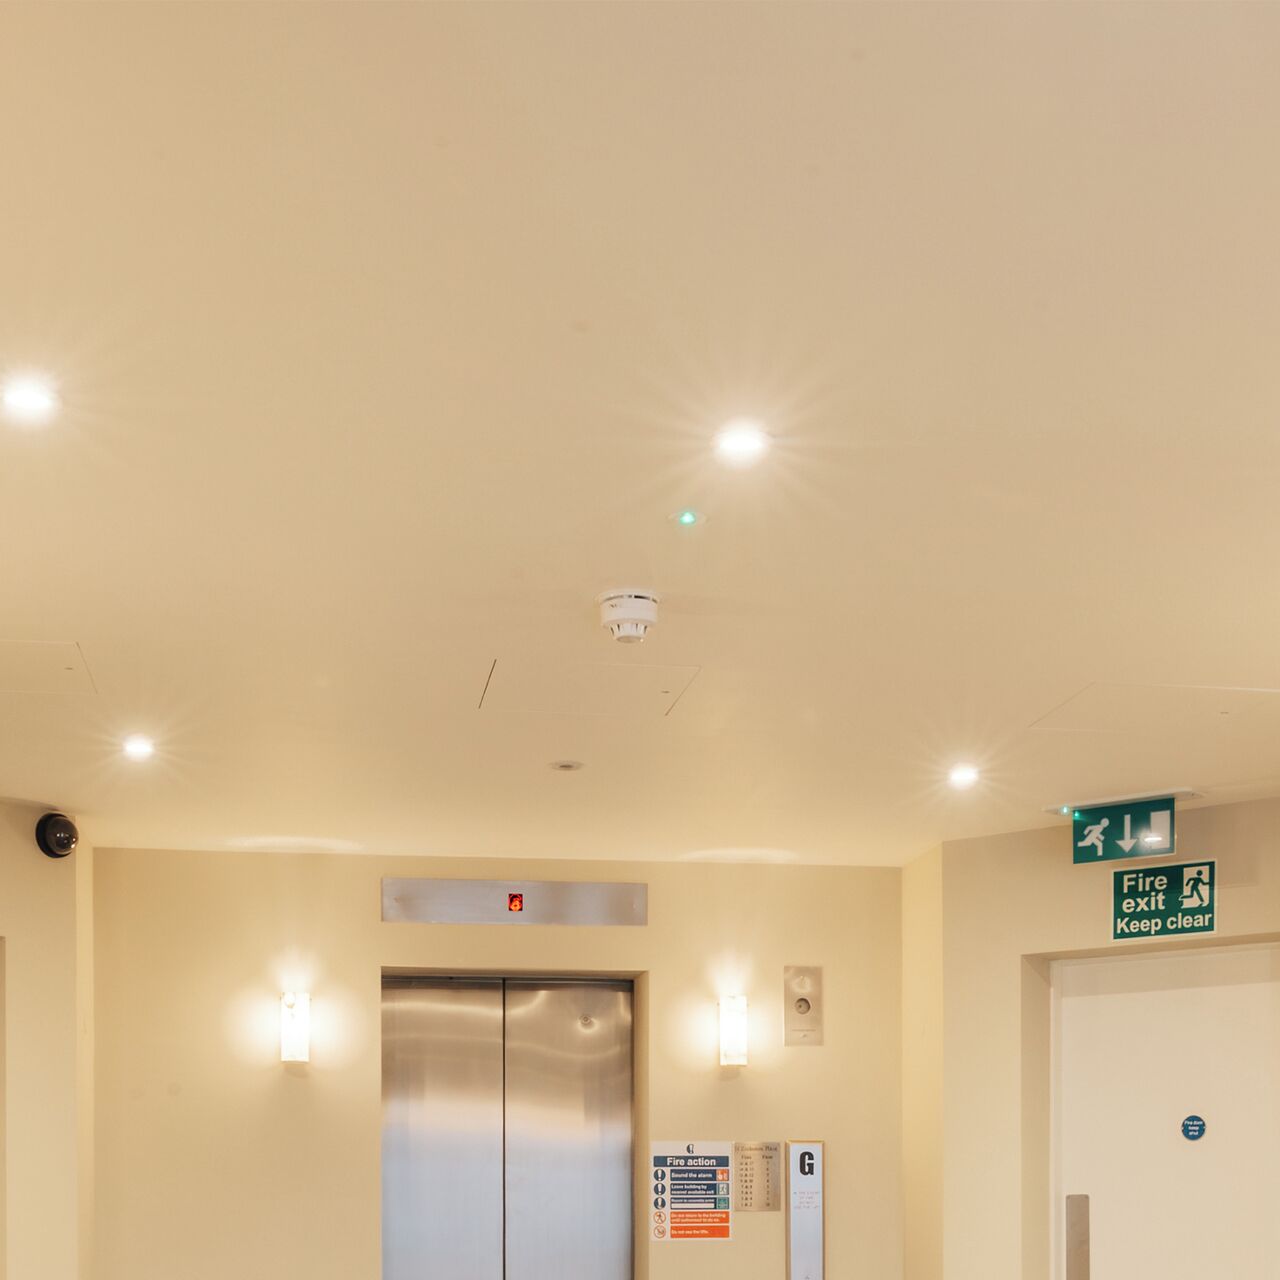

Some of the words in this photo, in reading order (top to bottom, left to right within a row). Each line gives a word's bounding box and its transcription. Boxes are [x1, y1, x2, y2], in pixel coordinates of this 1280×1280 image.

[1123, 873, 1168, 893] Fire
[1122, 892, 1166, 913] exit
[1116, 917, 1162, 935] Keep
[1166, 912, 1213, 929] clear
[666, 1157, 685, 1166] Fire
[687, 1157, 716, 1166] action
[799, 1151, 815, 1176] G
